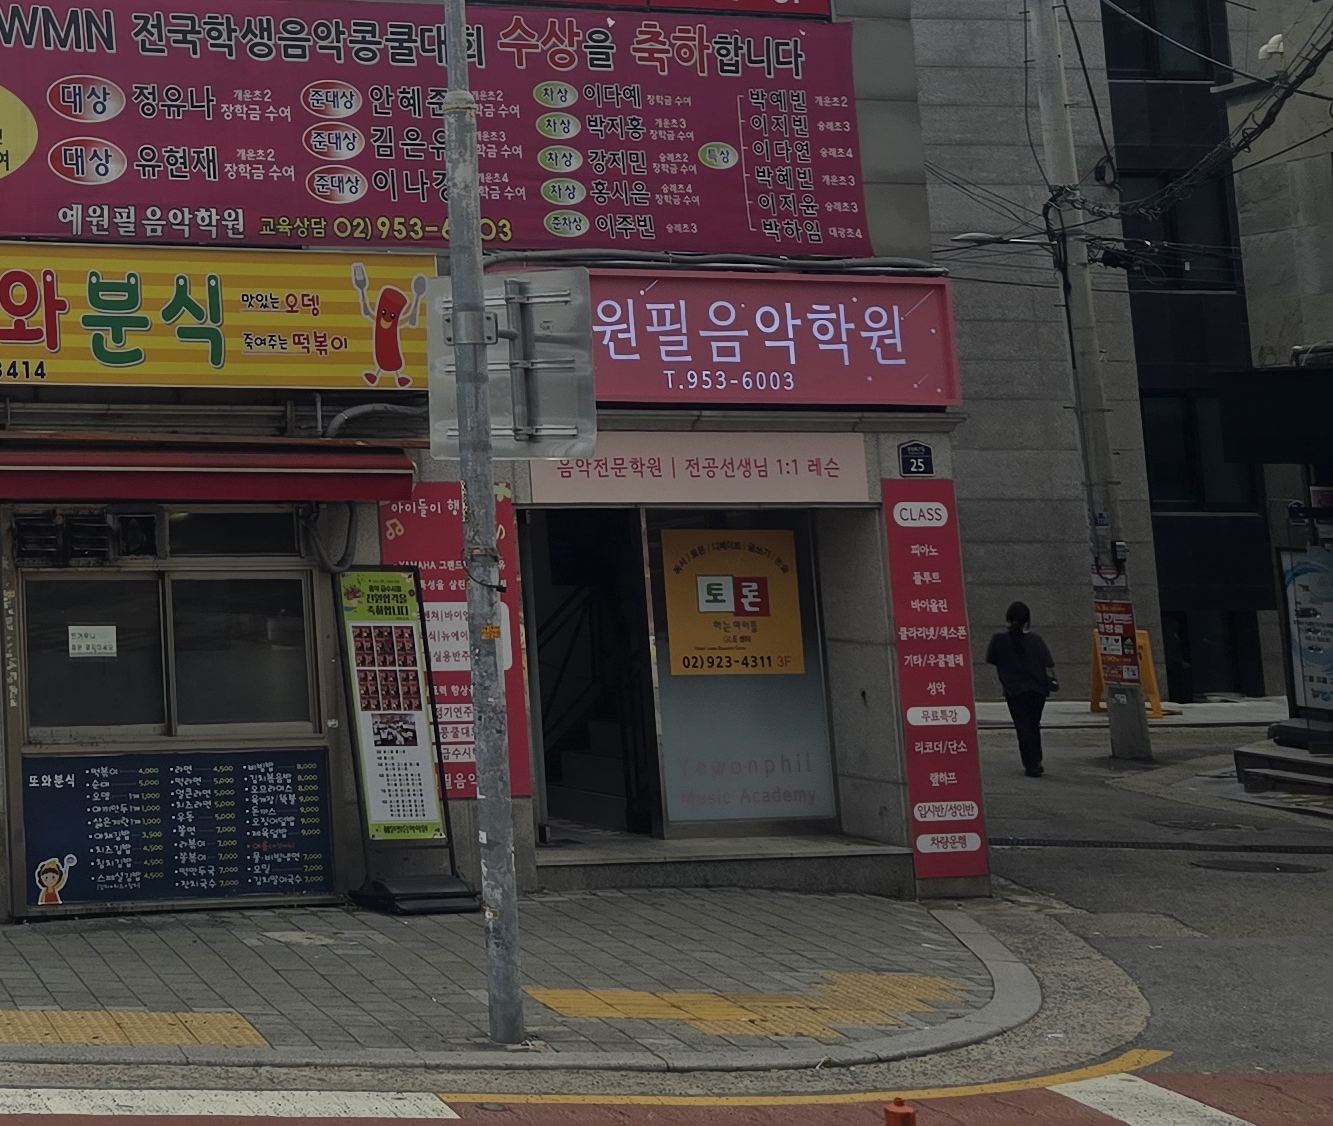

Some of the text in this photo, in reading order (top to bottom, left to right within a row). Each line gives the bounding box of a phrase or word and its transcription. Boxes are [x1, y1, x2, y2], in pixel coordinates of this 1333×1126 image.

[497, 16, 616, 70] 수상을
[630, 20, 805, 78] 축하합니다
[60, 83, 216, 121] 대상 정유나
[584, 83, 642, 109] 이다예
[749, 89, 807, 112] 박예빈
[134, 145, 219, 181] 유현재
[588, 149, 647, 175] 강지민
[592, 299, 906, 366] 원필음악학원
[291, 331, 349, 357] 떡볶이
[664, 370, 795, 391] T.953-6003
[557, 457, 840, 478] 음악전문학원 전공선생님 1:1 레슨
[910, 458, 925, 472] 25
[899, 506, 942, 522] CLASS
[910, 544, 938, 557] 피아노
[910, 599, 948, 612] 바이올린
[927, 682, 946, 696] 성악
[915, 741, 967, 754] 리코더/단소
[90, 766, 118, 777] 떡볶이
[175, 765, 192, 774] 라면
[248, 762, 274, 772] 비빔밥
[28, 774, 75, 788] 또와분식
[177, 811, 194, 822] 우동
[252, 806, 276, 816] 돈까스
[94, 830, 130, 841] 야채김밥
